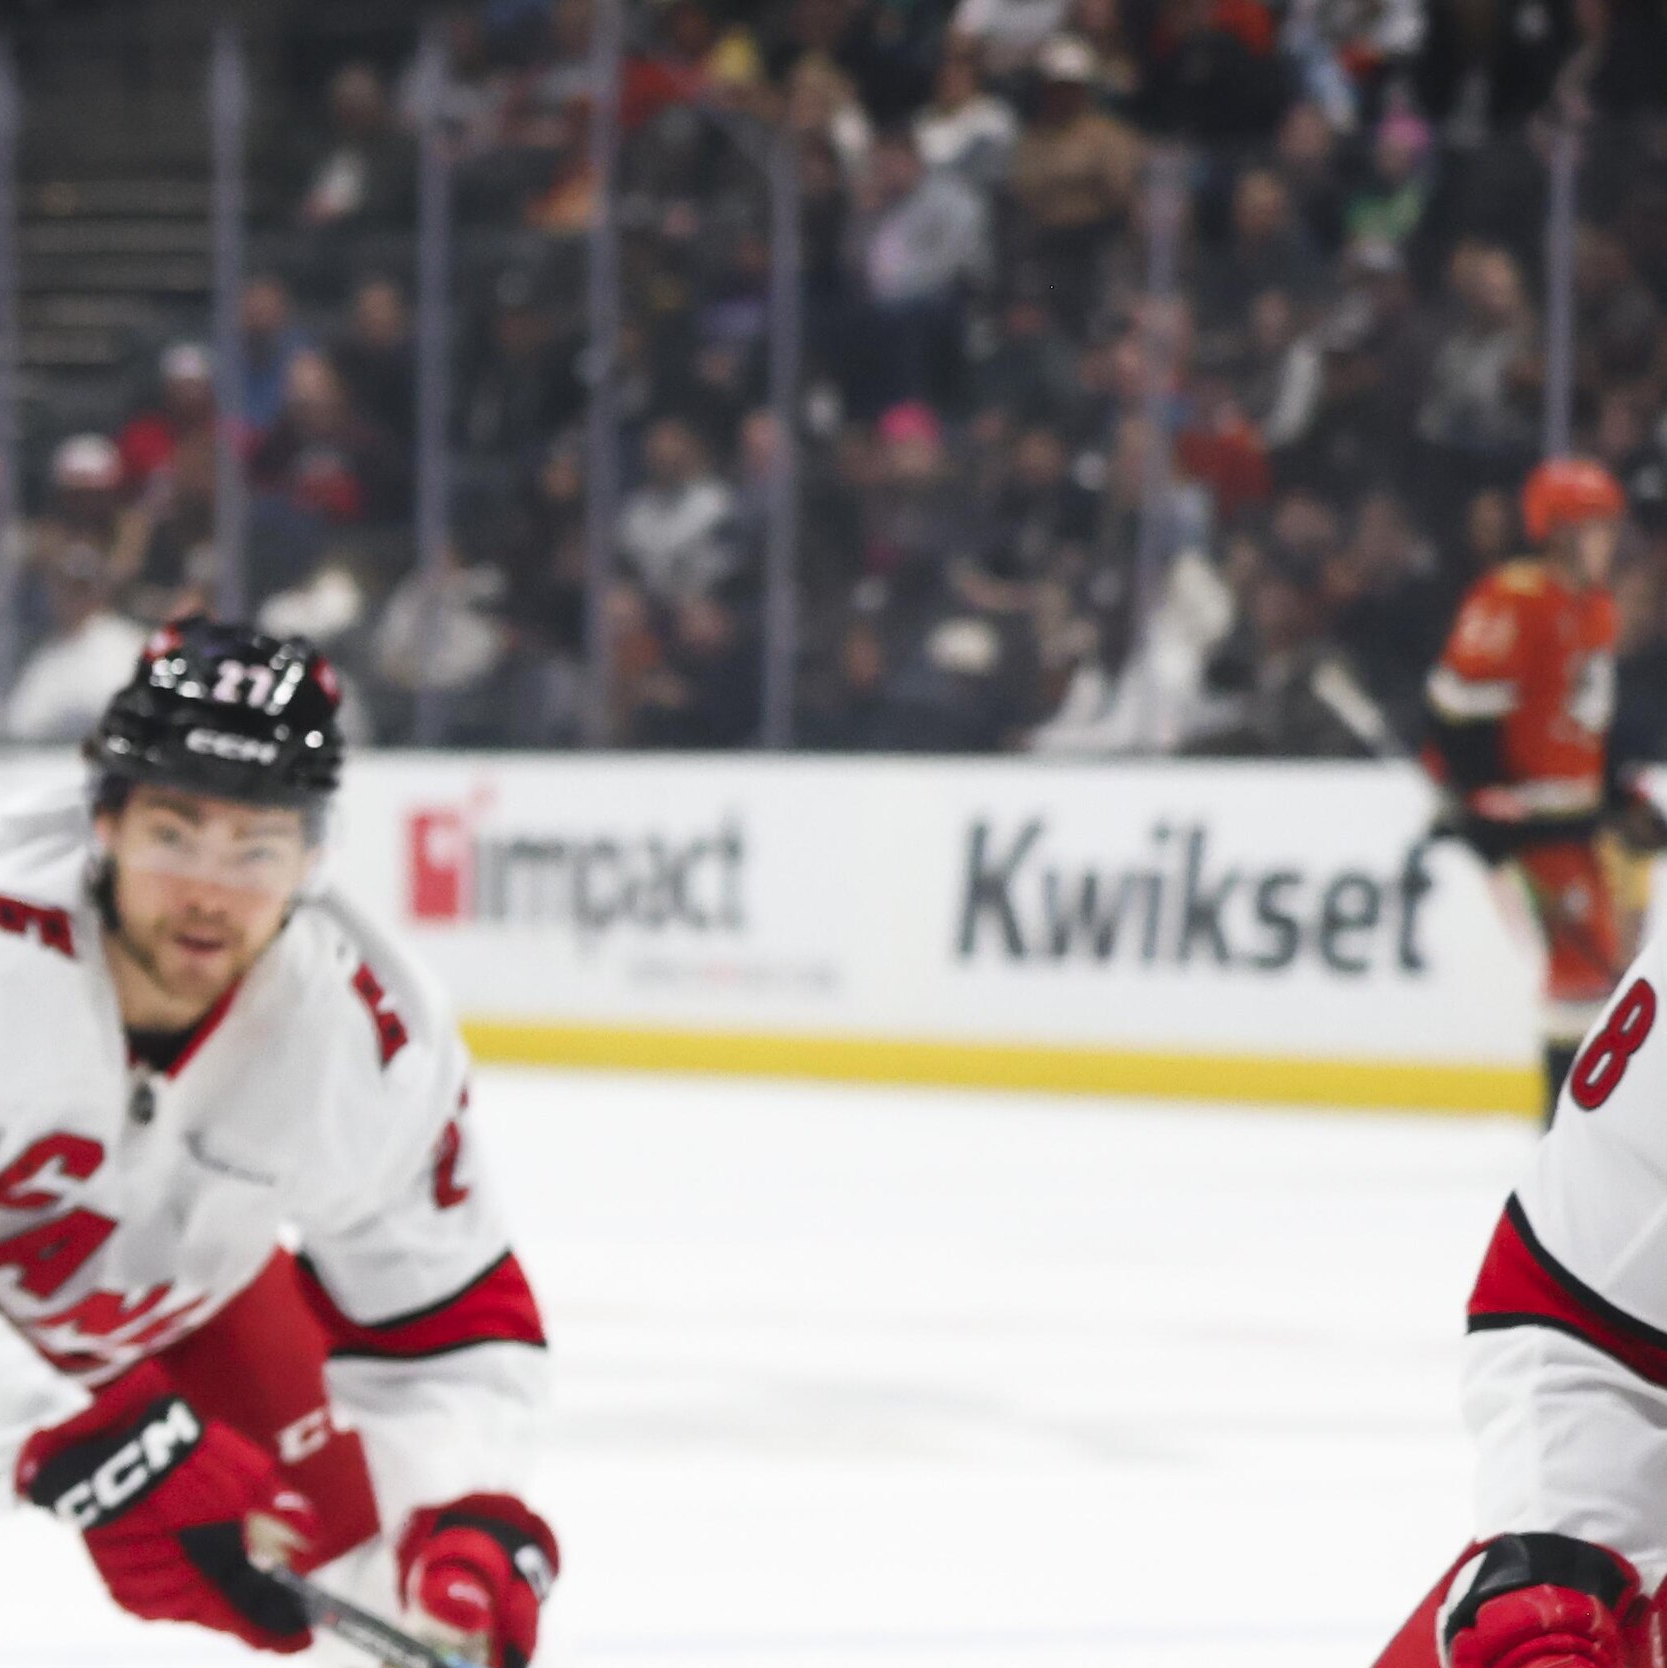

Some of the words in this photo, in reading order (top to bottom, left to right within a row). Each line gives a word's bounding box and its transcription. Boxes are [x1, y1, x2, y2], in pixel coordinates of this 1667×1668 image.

[953, 820, 1433, 974] Kwikset
[1570, 977, 1657, 1112] 8
[54, 1398, 201, 1528] CCM
